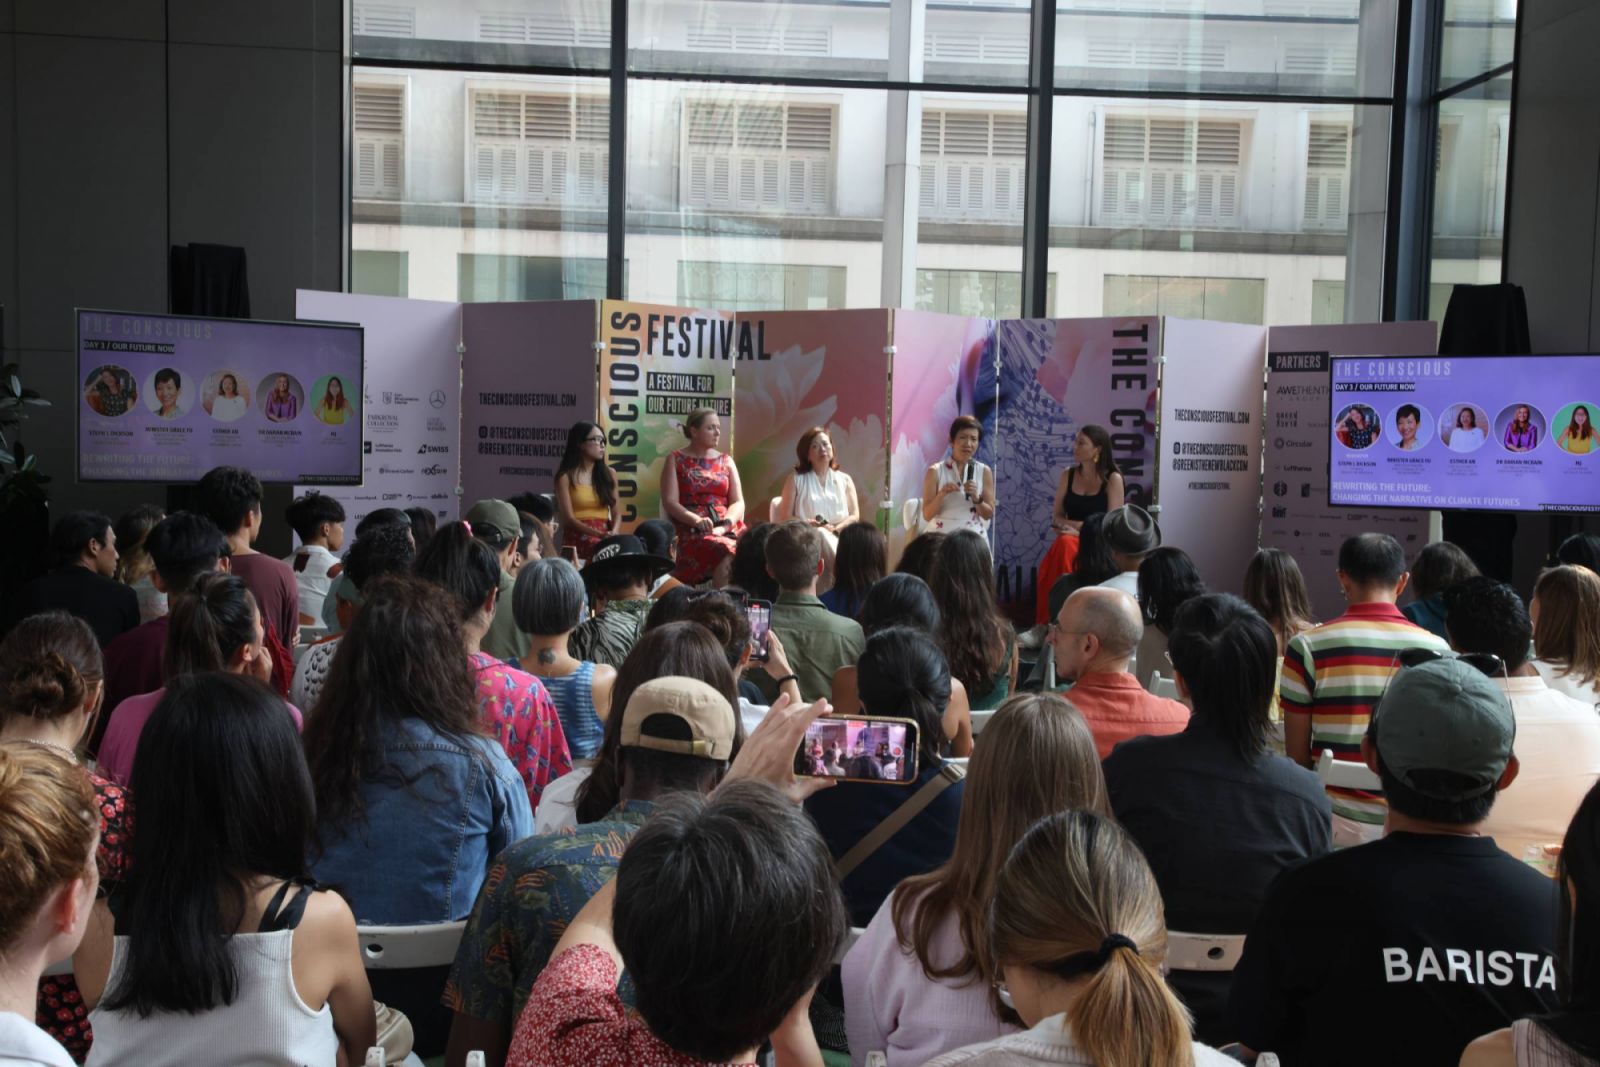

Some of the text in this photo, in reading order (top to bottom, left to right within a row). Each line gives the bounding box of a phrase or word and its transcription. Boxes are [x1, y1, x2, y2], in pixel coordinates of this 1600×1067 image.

[84, 317, 213, 338] THE CONSCIOUS
[647, 314, 772, 360] FESTIVAL
[85, 341, 98, 349] DAY
[112, 342, 127, 350] OUR
[129, 343, 155, 352] FUTURE
[157, 344, 174, 353] NOW
[1111, 324, 1148, 390] THE
[1276, 355, 1321, 369] PARTNERS
[1335, 361, 1451, 376] THE CONSCIOUS
[649, 374, 712, 392] A FESTIVAL FOR
[1277, 385, 1329, 395] AWETHENTI
[479, 392, 576, 407] THECONSCIOUSFESTIVAL.COM
[648, 397, 664, 413] OUR
[1175, 408, 1250, 424] THECONSCIOUSFESTIVAL.COM
[489, 426, 569, 441] @THECONSCIOUSFESTIV
[478, 442, 566, 457] @GREENISTHENEWBLACKC
[1182, 442, 1249, 456] @THECONSCIOUSFESTIVAL
[1173, 458, 1249, 471] @GREENISTHENEWBLACKCOM
[1333, 482, 1376, 491] REWRITING
[1380, 483, 1394, 491] THE
[1397, 483, 1431, 492] FUTURE:
[1333, 493, 1520, 506] CHANGING THE NARRATIVE ON CLIMATE FUTURES
[1383, 947, 1556, 991] BARISTA
